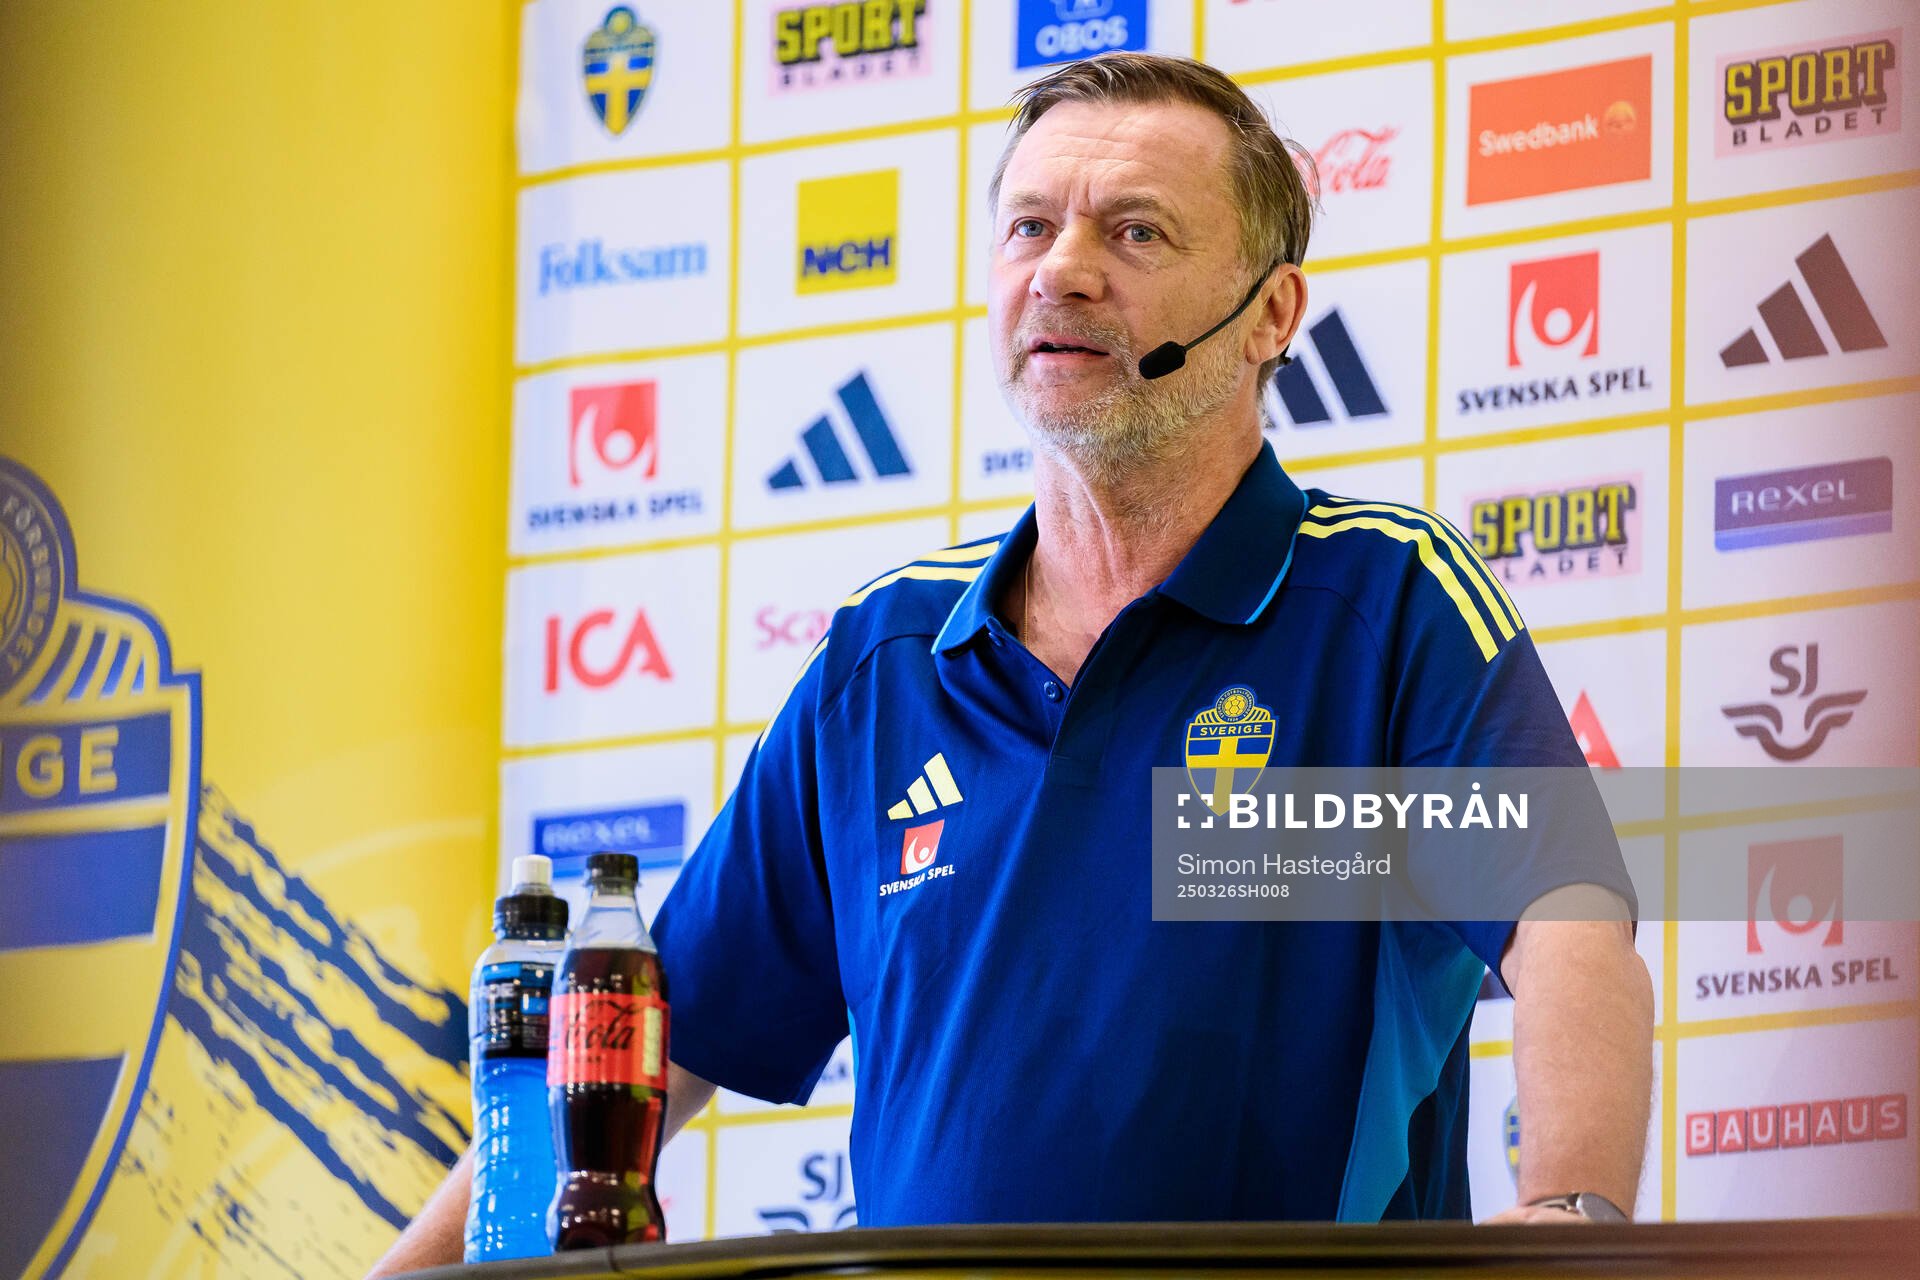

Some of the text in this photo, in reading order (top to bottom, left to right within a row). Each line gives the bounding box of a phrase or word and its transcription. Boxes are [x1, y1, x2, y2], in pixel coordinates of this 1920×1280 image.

[776, 0, 926, 65] SPORT
[1035, 15, 1128, 57] OBOS
[1723, 40, 1896, 124] SPORT
[1479, 113, 1599, 157] Swedbank
[1732, 108, 1887, 147] BLADET
[538, 241, 707, 297] Folksam
[801, 237, 893, 278] NCH
[1458, 368, 1653, 412] SVENSKA SPEL
[1471, 483, 1636, 561] SPORT
[1503, 552, 1629, 581] LADET
[545, 606, 672, 694] ICA
[1769, 643, 1820, 696] SJ
[1200, 724, 1262, 736] SVERIGE
[880, 864, 956, 896] SVENSKA SPEL
[1696, 957, 1899, 1000] SVENSKA SPEL
[1690, 1101, 1902, 1150] BAUHAUS
